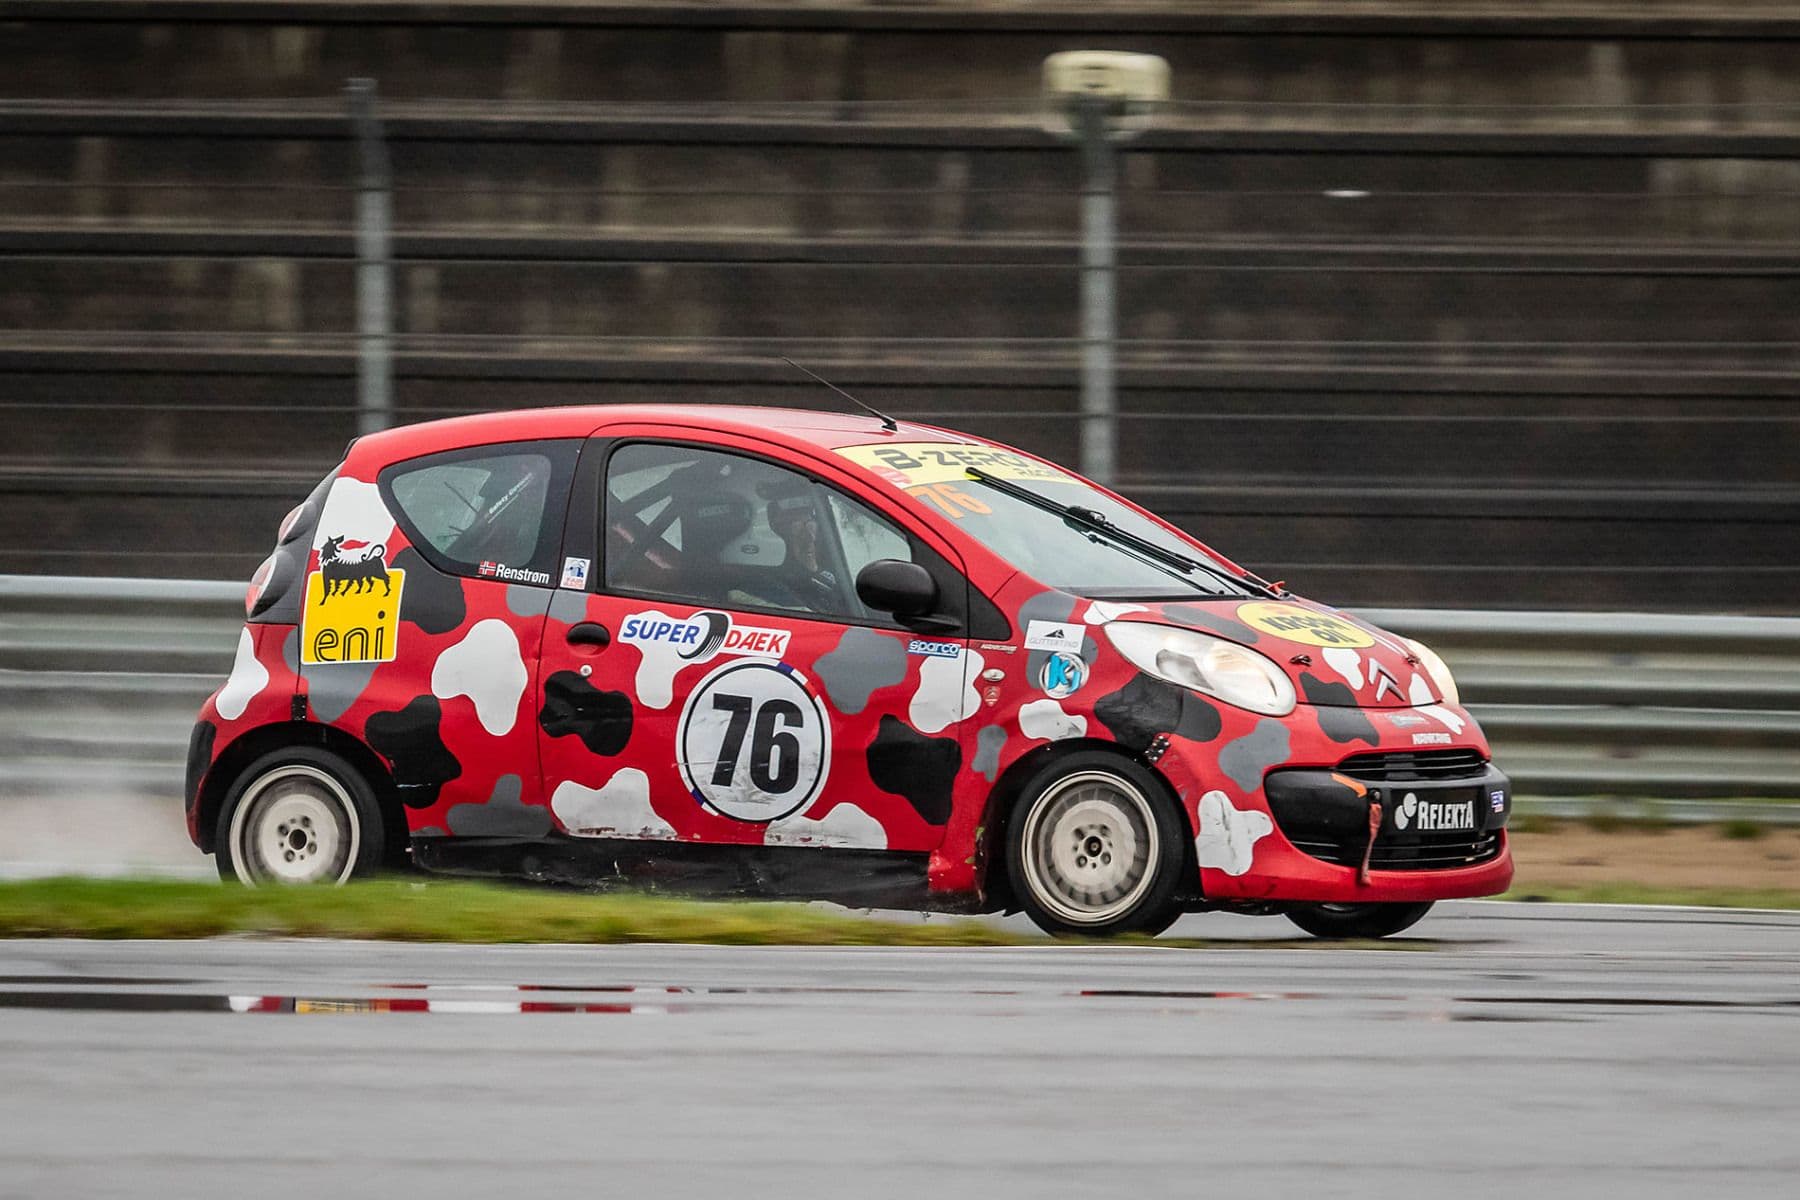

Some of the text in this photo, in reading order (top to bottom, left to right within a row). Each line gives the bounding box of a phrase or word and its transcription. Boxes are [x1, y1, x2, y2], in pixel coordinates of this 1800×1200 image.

[902, 483, 993, 519] 76
[495, 563, 550, 585] Renstrøm
[313, 610, 385, 662] eni
[622, 619, 787, 653] SUPER DAEK
[908, 640, 960, 655] sparco
[711, 692, 805, 795] 76
